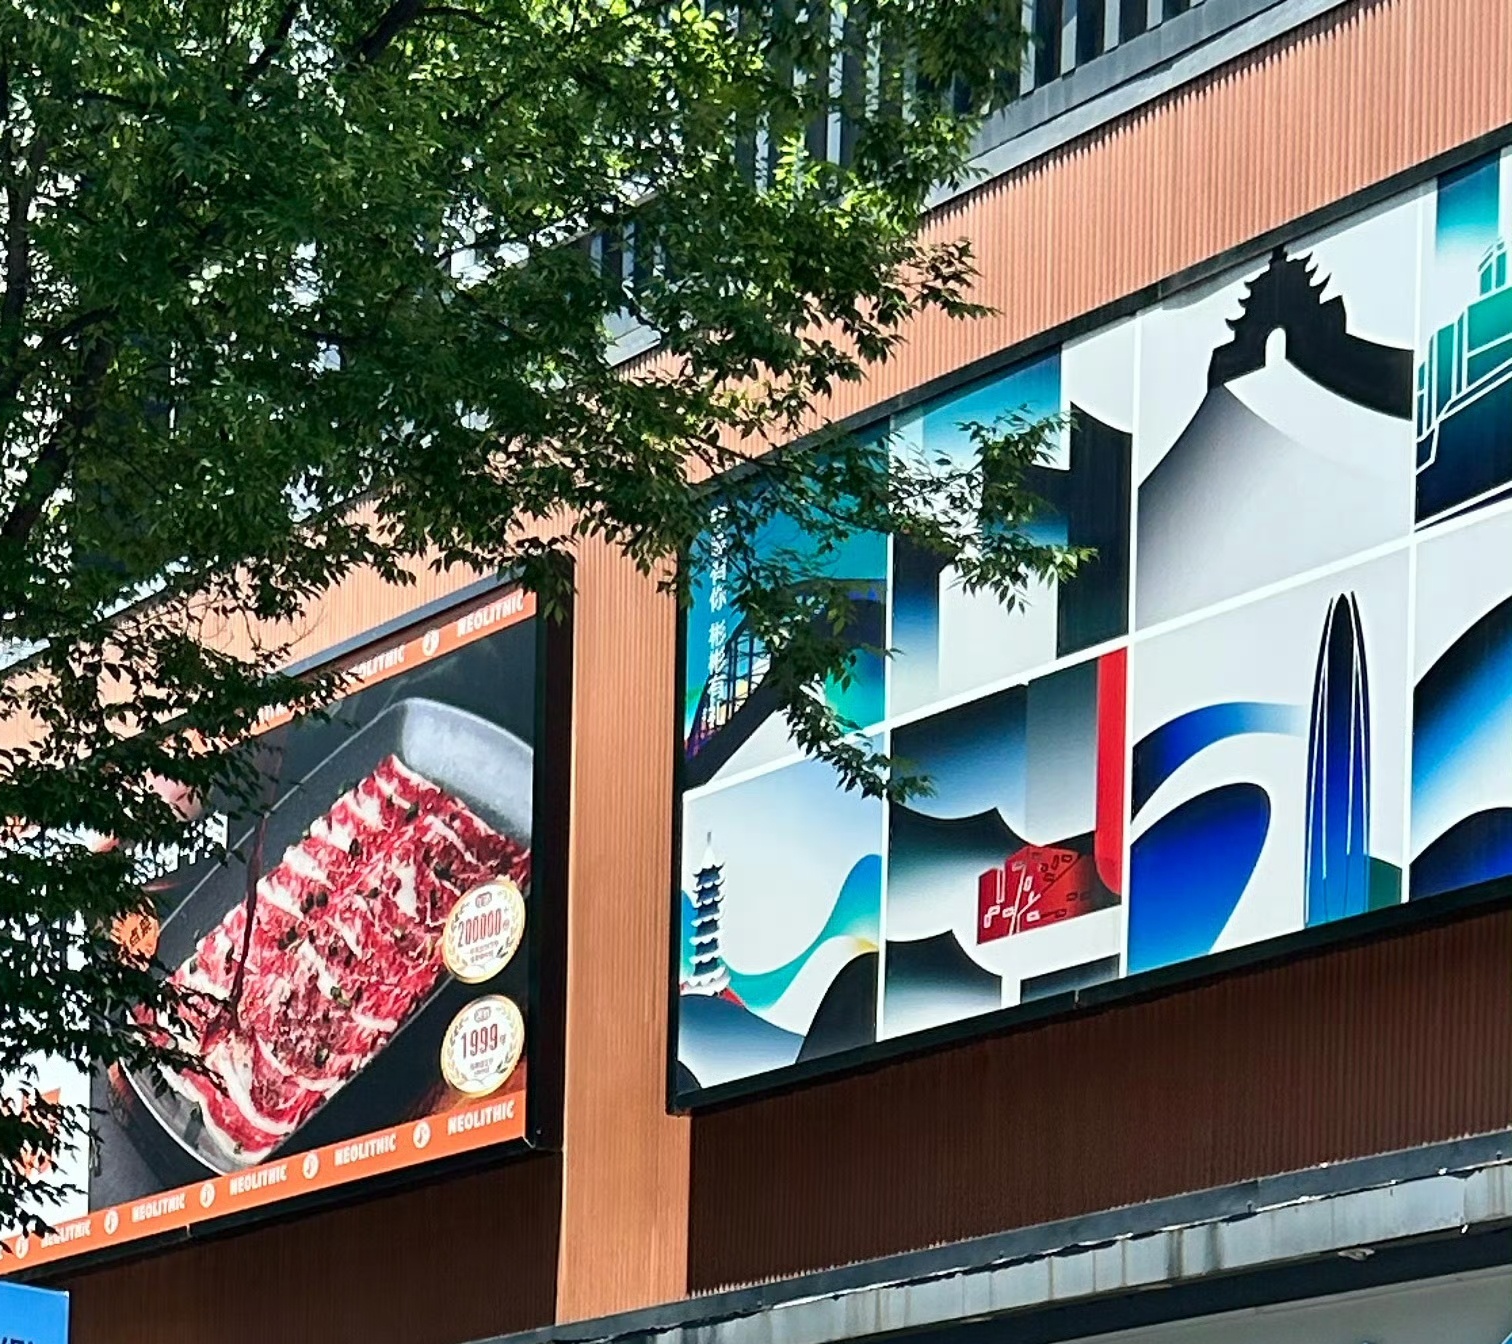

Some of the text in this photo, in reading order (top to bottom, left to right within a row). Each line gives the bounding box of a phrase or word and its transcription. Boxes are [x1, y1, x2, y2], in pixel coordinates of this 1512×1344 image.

[132, 1193, 186, 1222] NEOLITHIC
[229, 1164, 287, 1195] NEOLITHIC
[334, 1133, 396, 1166] NEOLITHIC
[447, 1101, 515, 1135] NEOLITHIC
